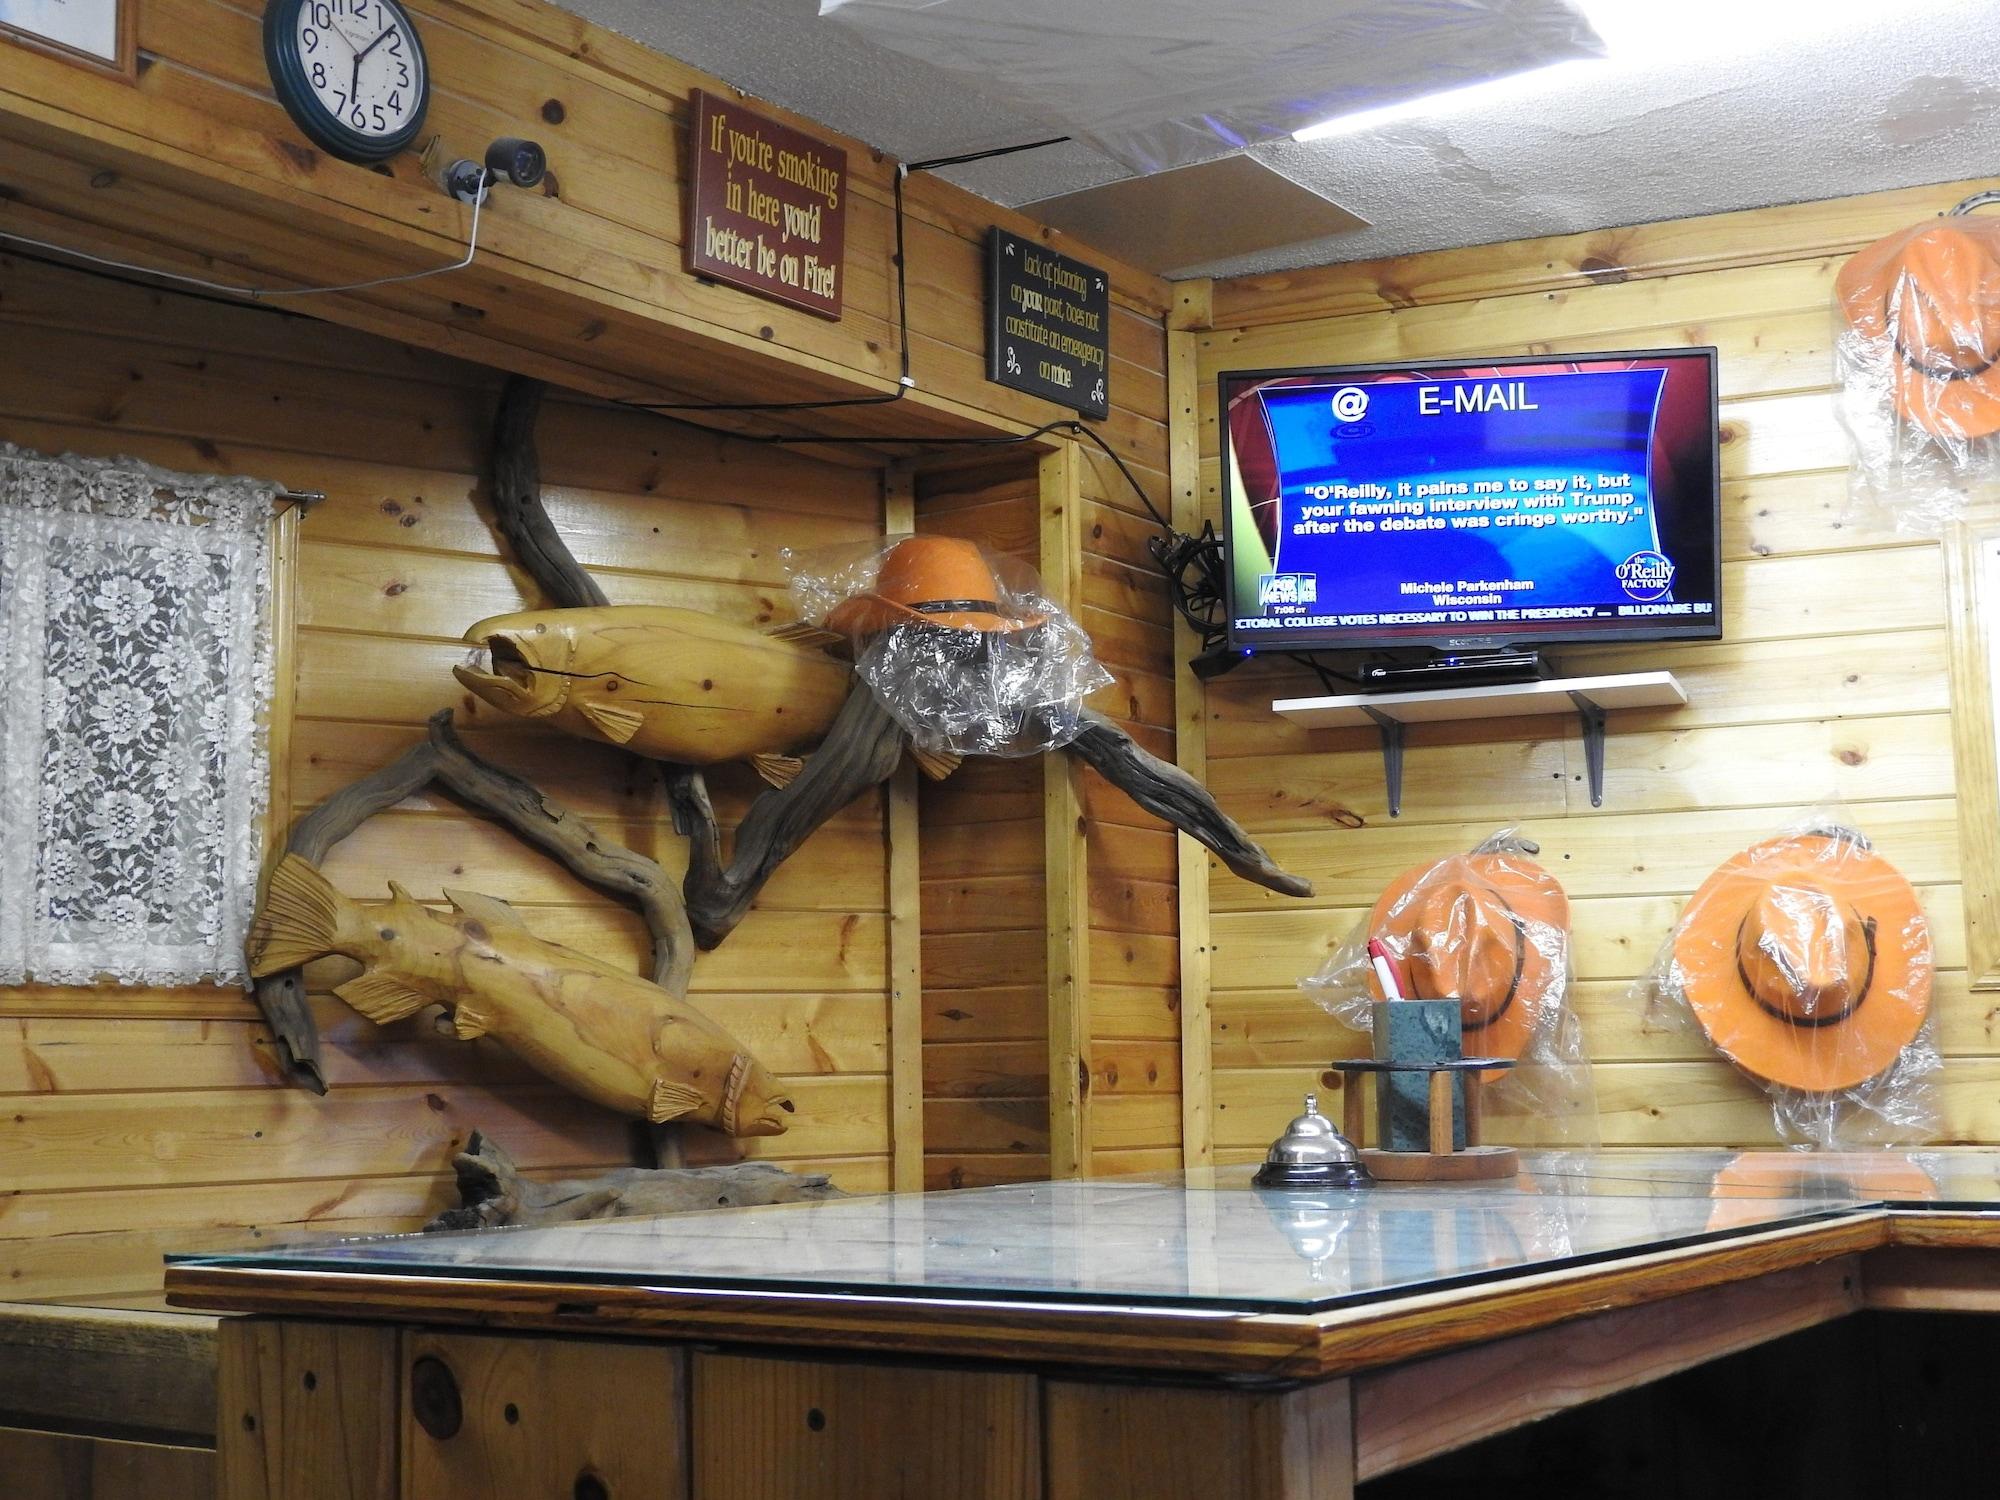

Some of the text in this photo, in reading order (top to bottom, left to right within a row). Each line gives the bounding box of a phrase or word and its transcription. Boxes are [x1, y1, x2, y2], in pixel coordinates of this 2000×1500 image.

[308, 0, 331, 30] 10
[374, 4, 382, 31] 1
[302, 28, 318, 54] 9
[388, 31, 402, 58] 2
[312, 62, 327, 89] 8
[396, 61, 409, 88] 3
[333, 90, 347, 117] 7
[351, 104, 366, 129] 6
[387, 90, 402, 116] 4
[372, 104, 386, 131] 5
[711, 115, 839, 209] If you're smoking
[726, 171, 821, 244] in here you'd
[705, 216, 836, 299] better be on Fire!
[1024, 249, 1087, 302] Lack of planning
[1010, 283, 1022, 303] on
[1043, 295, 1065, 322] part,
[1065, 302, 1085, 326] does
[1085, 307, 1100, 332] not
[1005, 315, 1104, 372] constitute an emergency
[1039, 360, 1050, 380] on
[1331, 382, 1539, 422] @ E-MAIL
[1304, 473, 1631, 502] "O'Reilly, it pains me to say it, but
[1301, 491, 1634, 520] your fawning interview with Trump
[1292, 506, 1645, 536] after the debate was cringe worthy."
[1615, 562, 1675, 584] O'Reilly
[1634, 556, 1646, 564] the
[1265, 590, 1298, 603] NEWS
[1400, 579, 1534, 594] Michele Parkenham
[1622, 579, 1665, 588] FACTOR
[1432, 593, 1502, 606] Wisconsin
[1284, 616, 1338, 628] COLLEGE
[1338, 614, 1378, 626] VOTES
[1379, 612, 1449, 625] NECESSARY
[1448, 611, 1467, 622] TO
[1468, 610, 1494, 621] WIN
[1495, 609, 1520, 620] THE
[1521, 607, 1595, 619] PRESIDENCY
[1618, 603, 1692, 616] BILLIONAIRE
